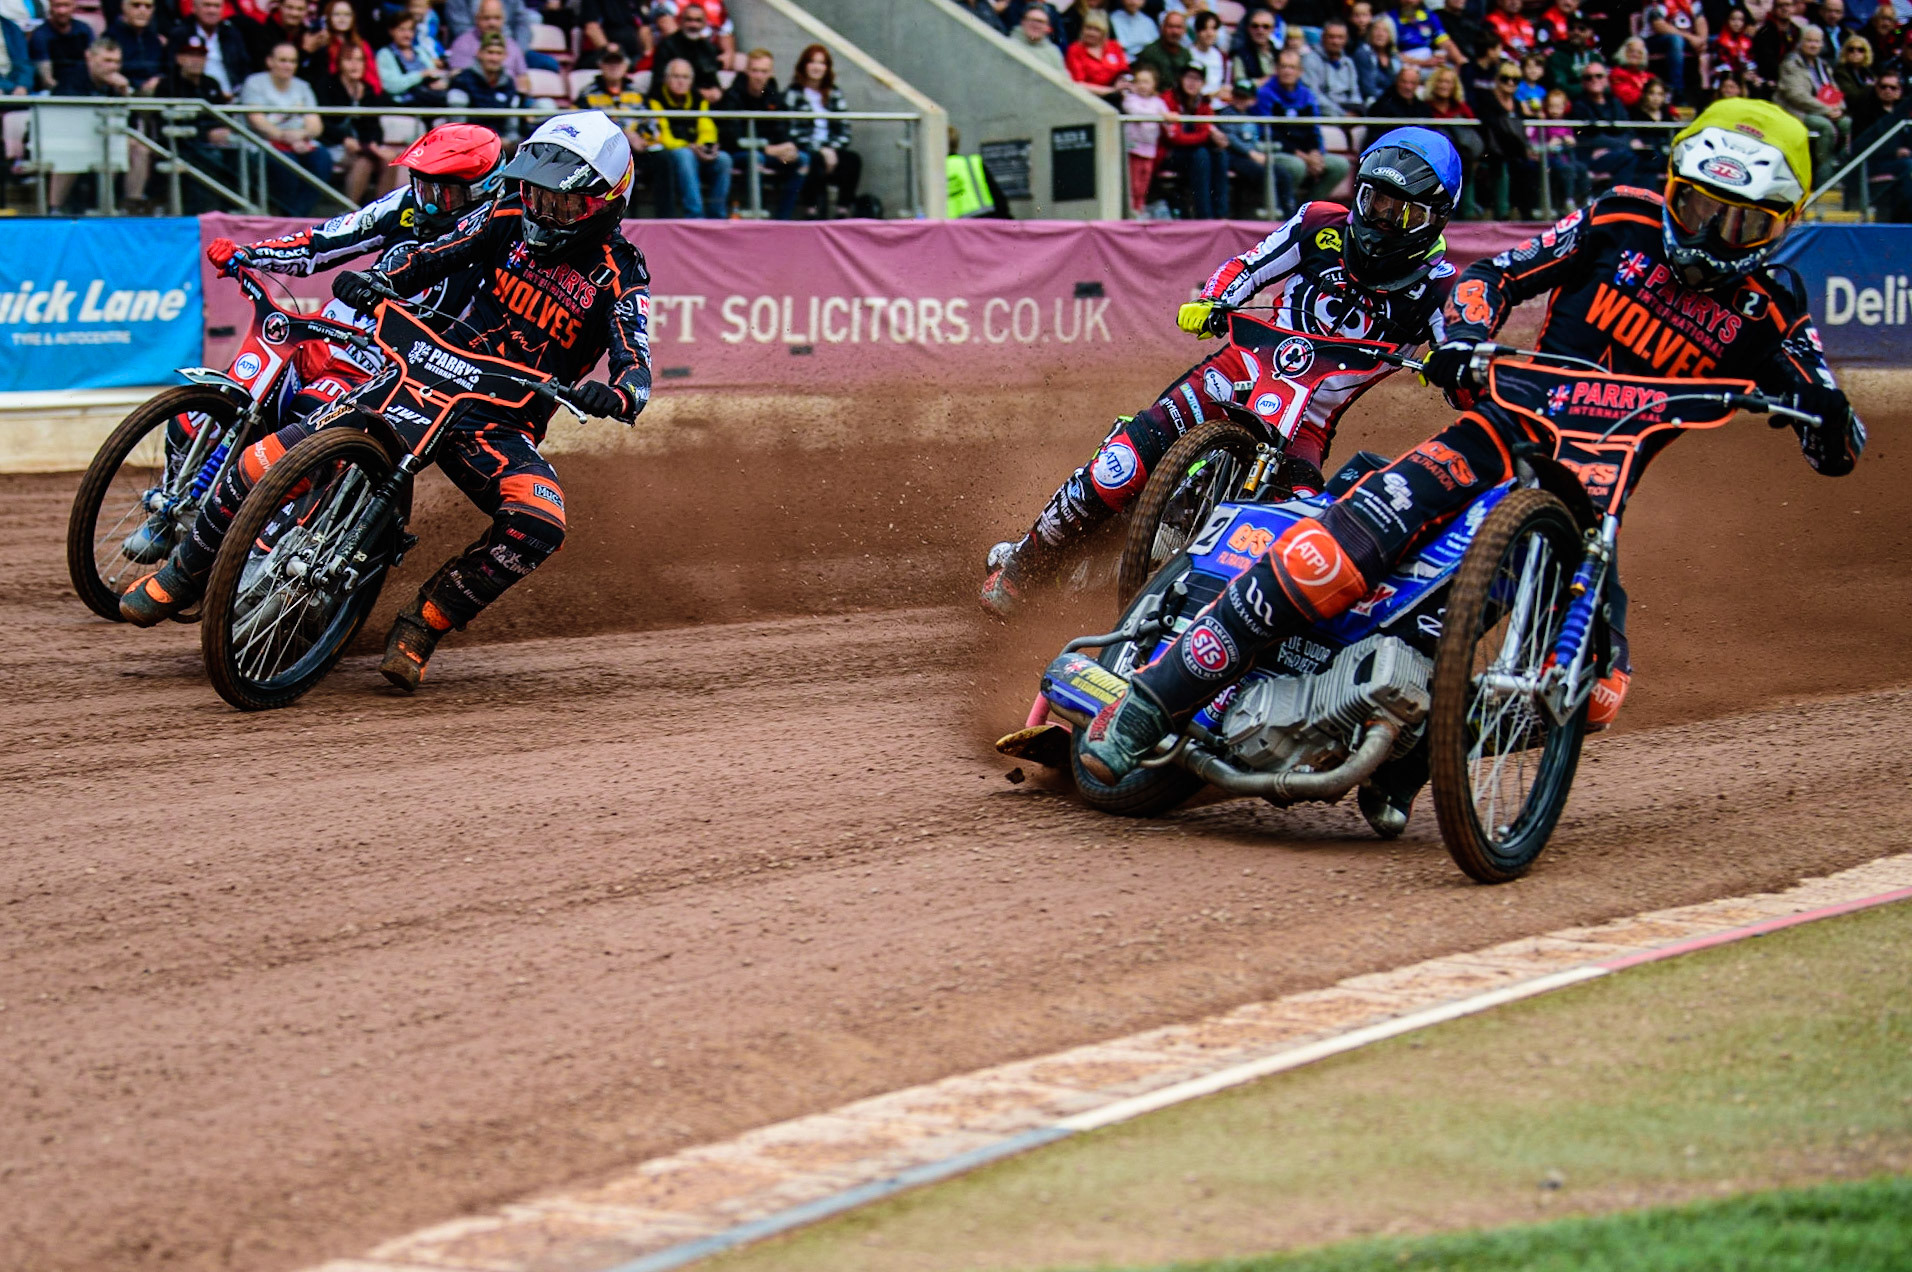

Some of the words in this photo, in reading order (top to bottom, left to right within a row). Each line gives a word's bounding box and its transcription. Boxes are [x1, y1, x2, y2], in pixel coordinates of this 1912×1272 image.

[1376, 167, 1403, 183] SHOEI
[1708, 162, 1742, 178] STS
[596, 269, 611, 284] 1
[78, 279, 187, 323] Lane
[492, 268, 582, 349] WOLVES
[1644, 263, 1742, 344] PARRYS
[1742, 292, 1759, 315] 2
[1825, 275, 1912, 326] Deli
[721, 296, 1111, 344] SOLICITORS.CO.UK
[1636, 288, 1725, 359] INTERNATIONAL
[11, 331, 41, 346] TYRE
[239, 360, 256, 374] ATPI
[428, 347, 483, 384] PARRYS
[1259, 400, 1277, 410] ATPI
[1572, 381, 1668, 413] PARRYS
[387, 404, 432, 425] JWP
[1568, 406, 1662, 422] INTERNATNAL
[1105, 451, 1126, 479] ATPI
[1408, 453, 1456, 491] FILTRATION
[1196, 517, 1230, 546] 2
[1295, 541, 1329, 575] ATPI
[1194, 634, 1222, 665] STS
[1277, 649, 1319, 673] PROJECT
